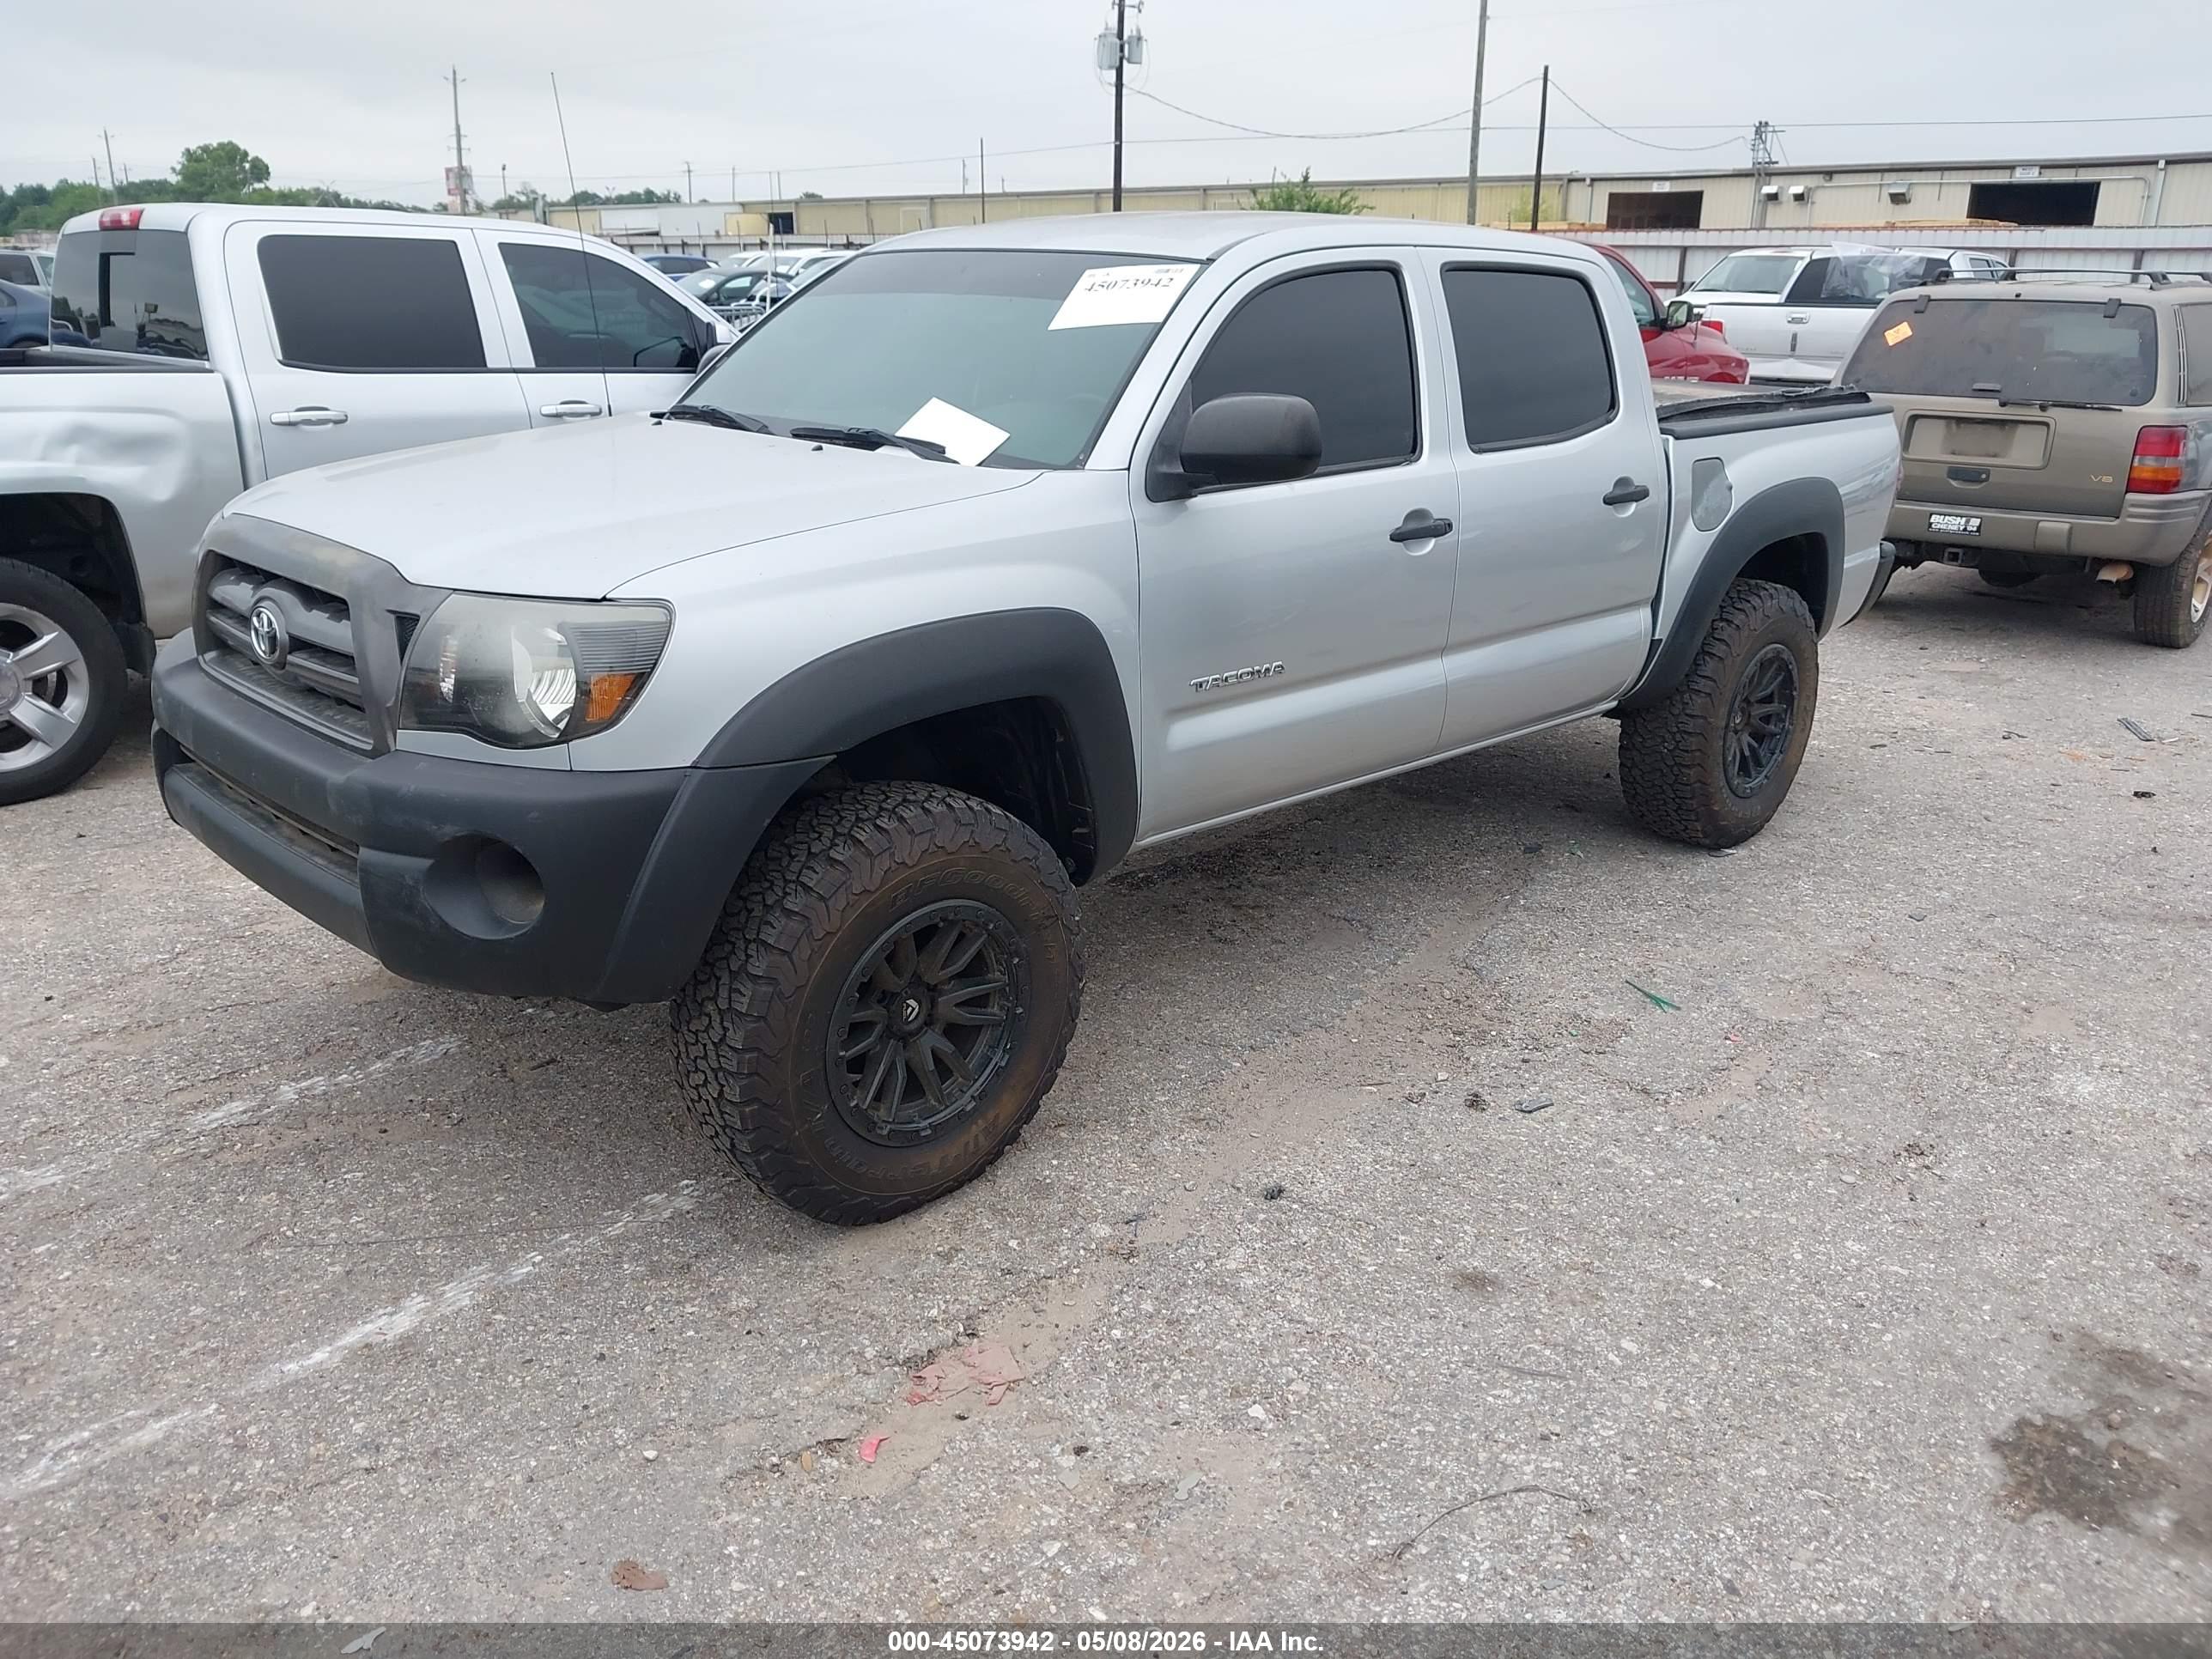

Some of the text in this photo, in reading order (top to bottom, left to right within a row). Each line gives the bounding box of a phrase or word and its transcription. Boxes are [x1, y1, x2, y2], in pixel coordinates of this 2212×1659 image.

[1085, 277, 1174, 292] 45073942
[1929, 514, 1966, 525] BUSH
[1931, 522, 1965, 531] CHENEY
[1188, 660, 1285, 692] TACOMA
